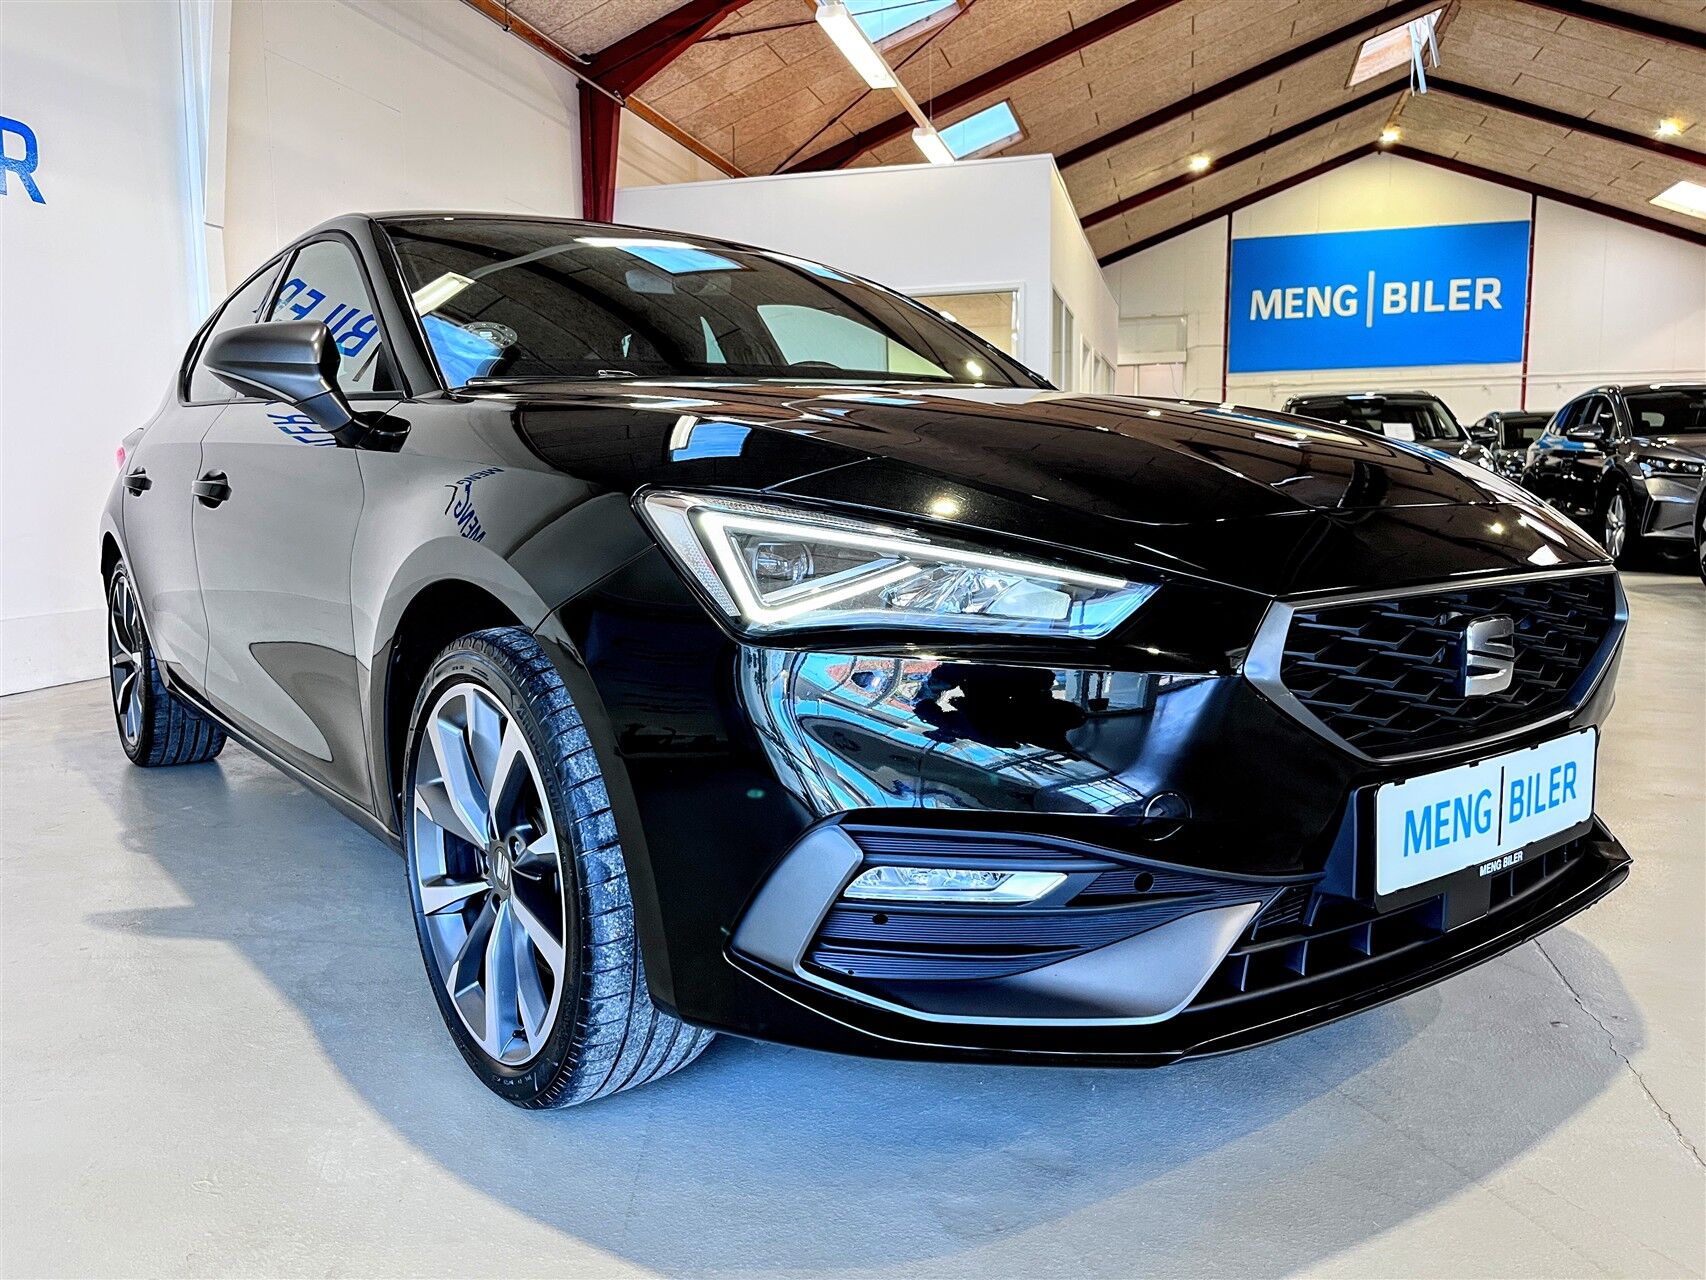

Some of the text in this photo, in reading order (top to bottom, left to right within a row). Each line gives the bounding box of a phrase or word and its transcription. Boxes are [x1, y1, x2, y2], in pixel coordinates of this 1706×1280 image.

[1250, 277, 1503, 320] MENG BILER
[1403, 761, 1577, 858] MENG BILER
[1479, 850, 1524, 877] MENG BILER
